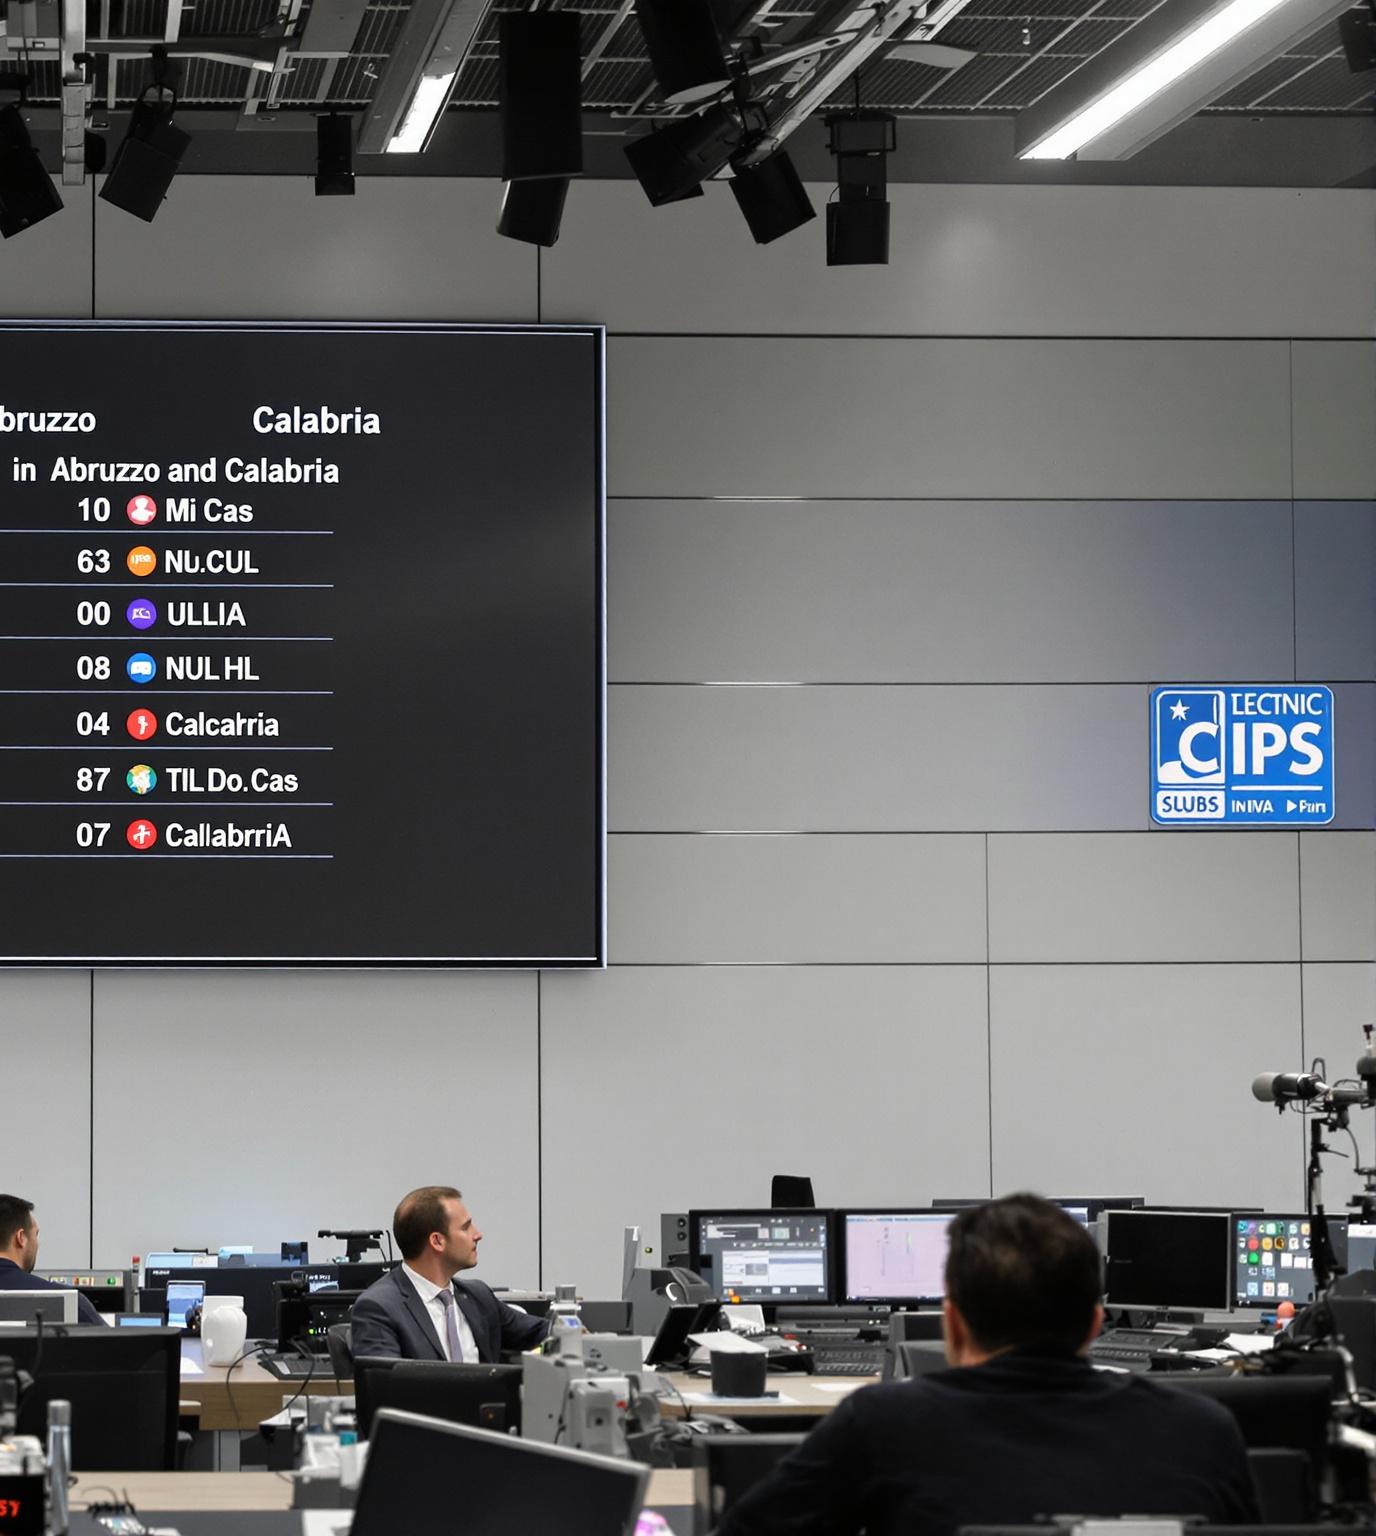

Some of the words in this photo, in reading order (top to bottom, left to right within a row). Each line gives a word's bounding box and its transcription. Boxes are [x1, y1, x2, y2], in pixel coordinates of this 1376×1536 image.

[252, 405, 381, 435] Calabria
[13, 456, 37, 482] in
[49, 456, 161, 483] Abruzzo
[167, 456, 217, 483] and
[224, 456, 340, 484] Calabria
[78, 497, 111, 522] 10
[165, 497, 197, 523] Mi
[203, 497, 254, 523] Cas
[77, 548, 111, 574] 63
[76, 600, 111, 626] 00
[167, 601, 247, 627] ULLIA
[76, 655, 111, 681] 08
[76, 711, 111, 736] 04
[76, 767, 111, 792] 87
[1161, 795, 1220, 814] SLUBS
[76, 822, 111, 847] 07
